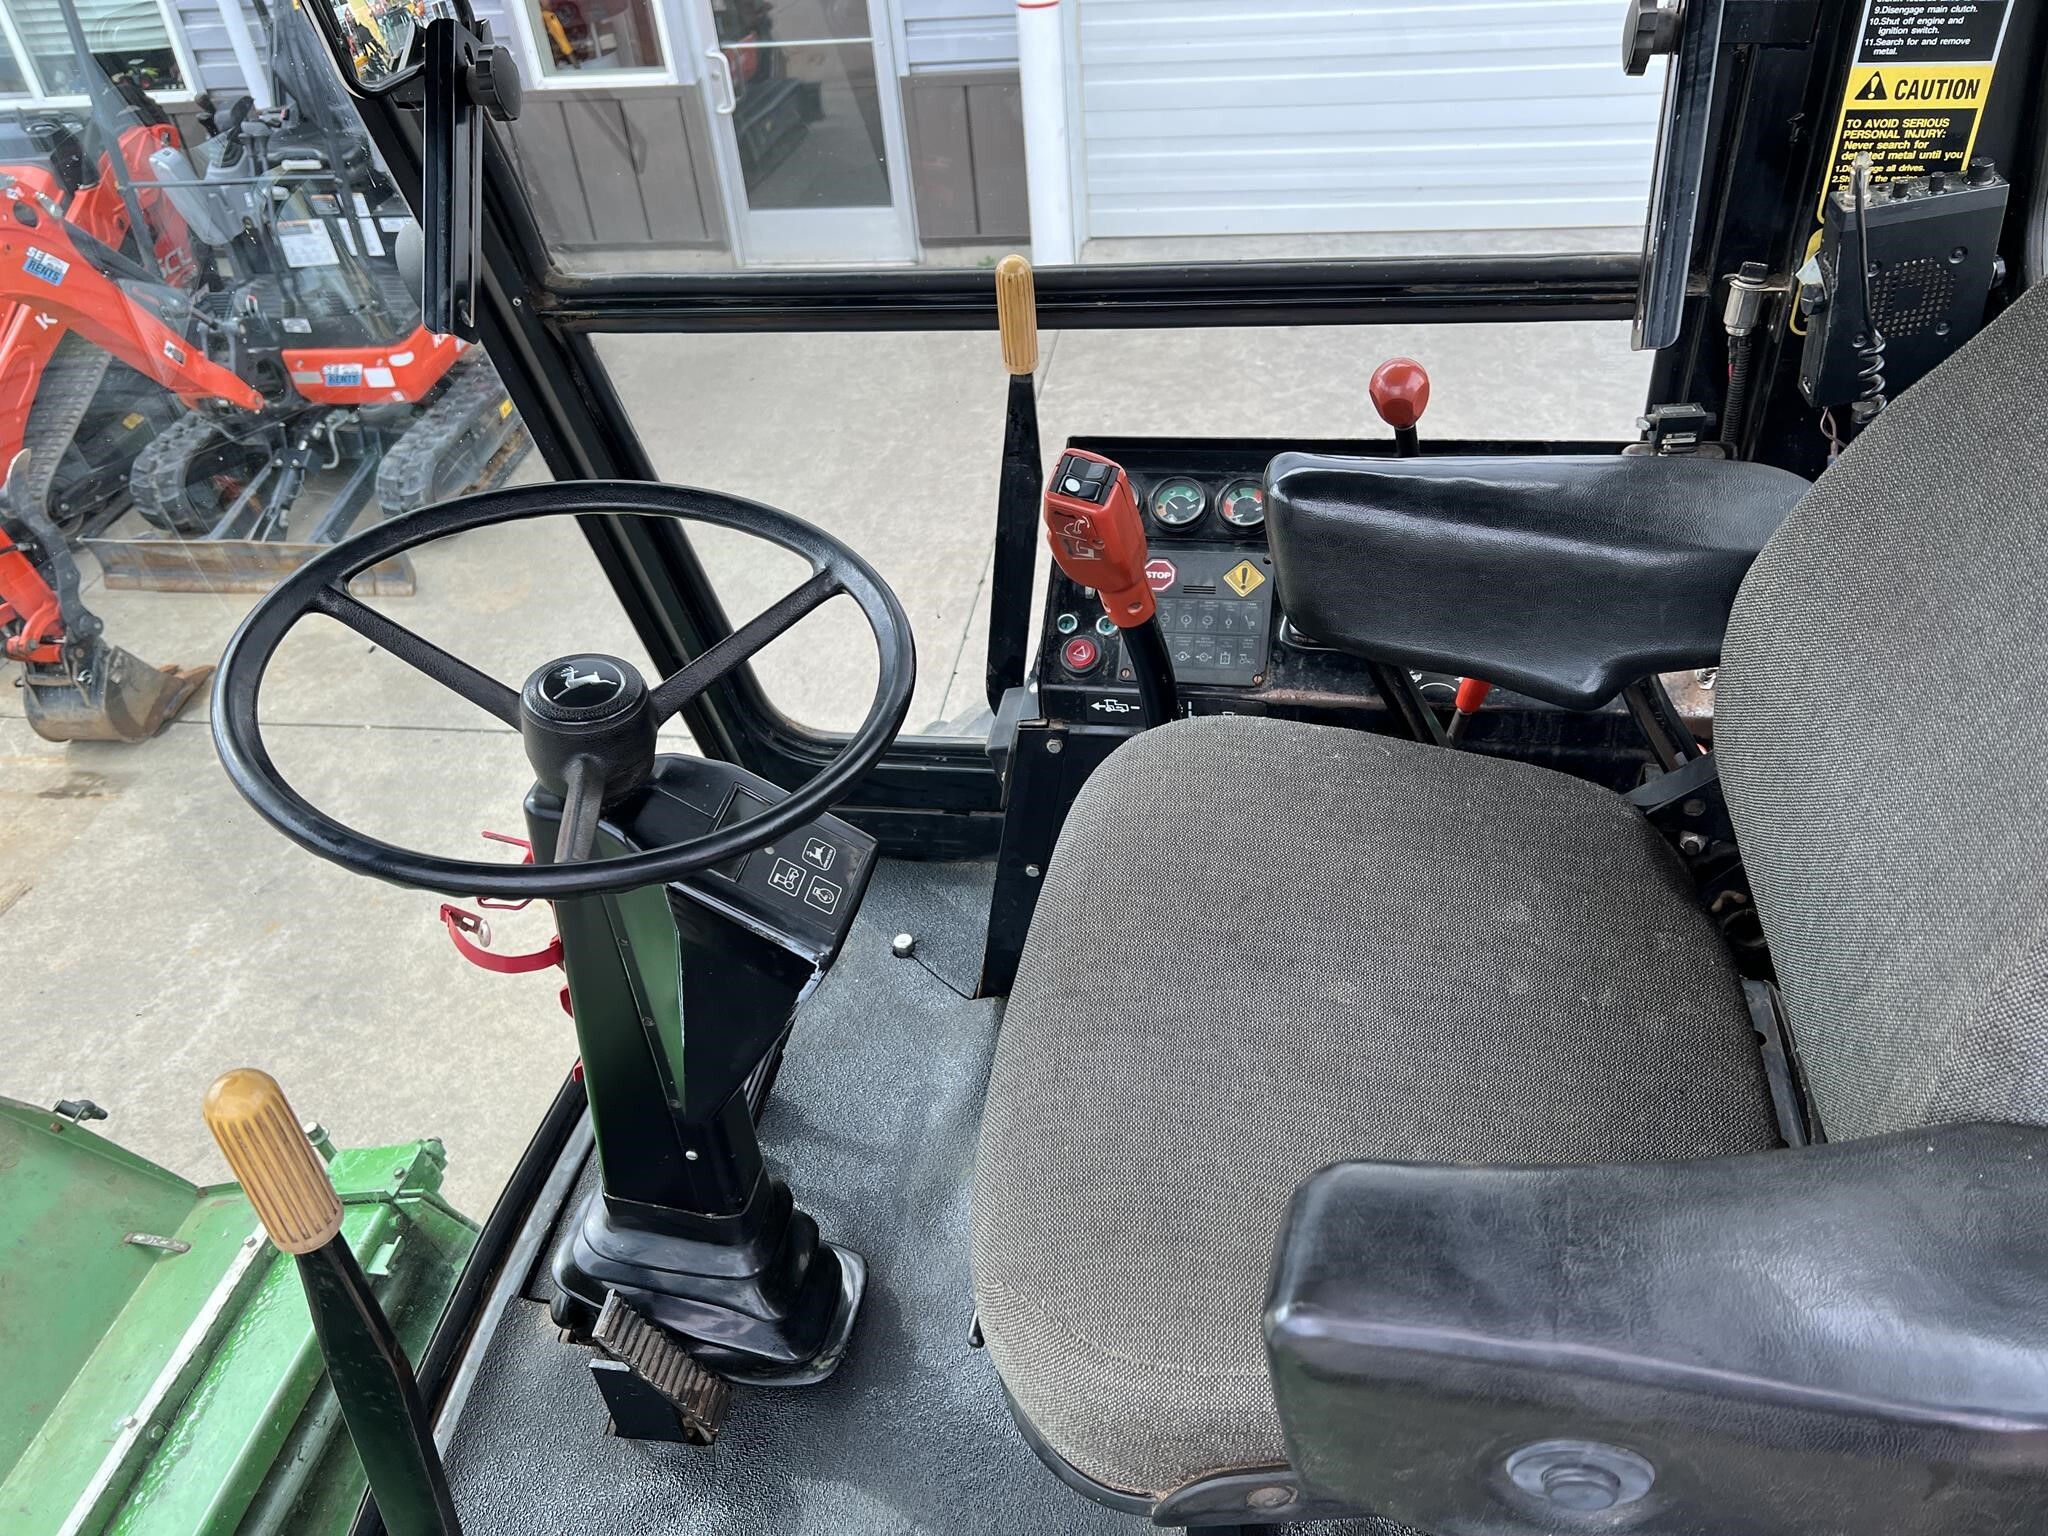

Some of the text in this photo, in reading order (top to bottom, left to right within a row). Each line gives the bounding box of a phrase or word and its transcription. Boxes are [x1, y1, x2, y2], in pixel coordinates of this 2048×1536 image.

[1927, 5, 1948, 13] main
[1950, 4, 1978, 13] clutch.
[1869, 16, 1964, 26] 10.Shut off engine and
[1878, 26, 1940, 36] ignition switch.
[1864, 38, 1904, 46] 11.Search
[1906, 38, 1919, 46] for
[1921, 38, 1937, 46] and
[1894, 78, 1981, 101] CAUTION
[1846, 118, 1950, 128] TO AVOID SERIOUS
[1843, 128, 1947, 139] PERSONAL INJURY:
[1843, 140, 1929, 150] Never search for
[1887, 151, 1916, 160] metal
[1919, 150, 1942, 159] until
[1944, 151, 1963, 161] you
[1886, 164, 1897, 172] all
[1898, 164, 1925, 172] drives.
[1875, 175, 1888, 183] the
[1146, 571, 1171, 579] STOP
